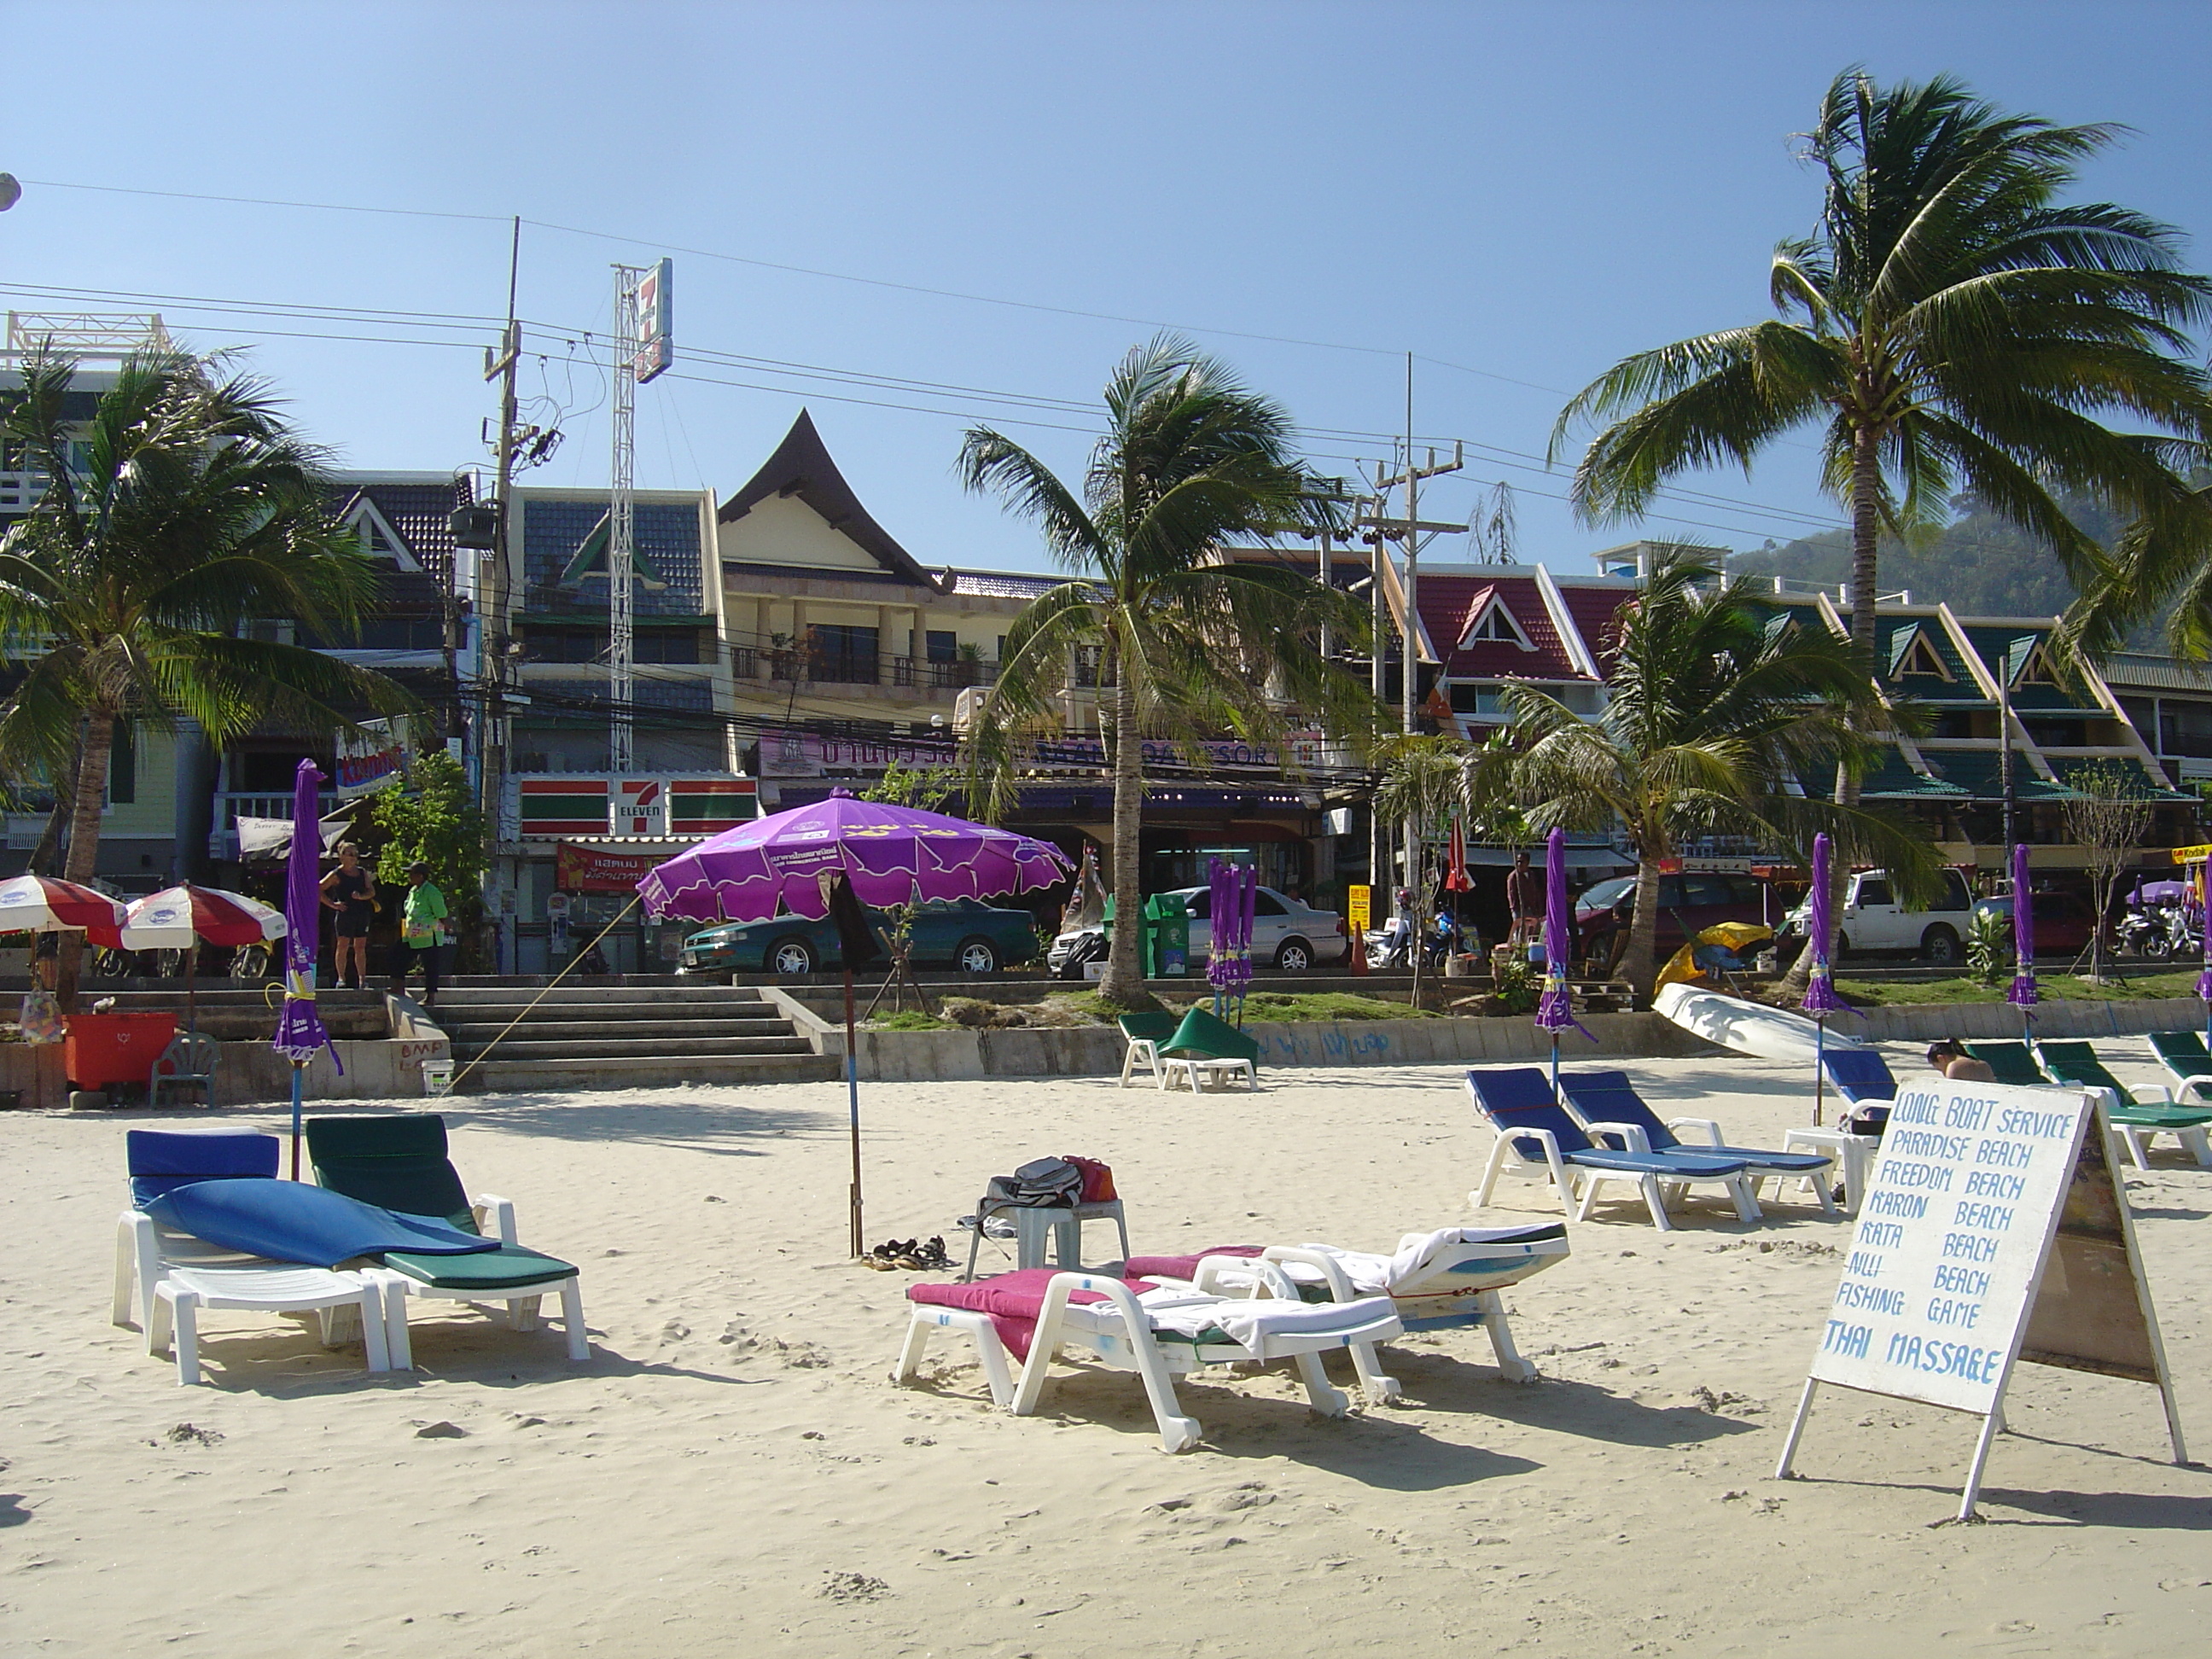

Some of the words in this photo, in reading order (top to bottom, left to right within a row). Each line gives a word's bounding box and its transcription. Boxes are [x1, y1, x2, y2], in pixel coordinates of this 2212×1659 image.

[622, 781, 659, 833] 7
[1893, 1091, 1941, 1125] LONG
[1945, 1097, 1999, 1131] BOAT
[1997, 1106, 2075, 1138] SERVICE
[1891, 1130, 1971, 1161] PARADISE
[1976, 1139, 2034, 1168] BEACH
[1880, 1160, 1953, 1191] FREEDOM
[1965, 1172, 2026, 1200] BEACH
[1869, 1190, 1930, 1219] KARON
[1953, 1202, 2015, 1231] BEACH
[1858, 1220, 1903, 1249] KATA
[1942, 1232, 2000, 1262] BEACH
[1933, 1265, 1991, 1297] BEACH
[1836, 1282, 1905, 1315] FISHING
[1928, 1297, 1982, 1329] GAME
[1824, 1319, 1873, 1359] THAI
[1887, 1332, 2004, 1384] MASSAGE
